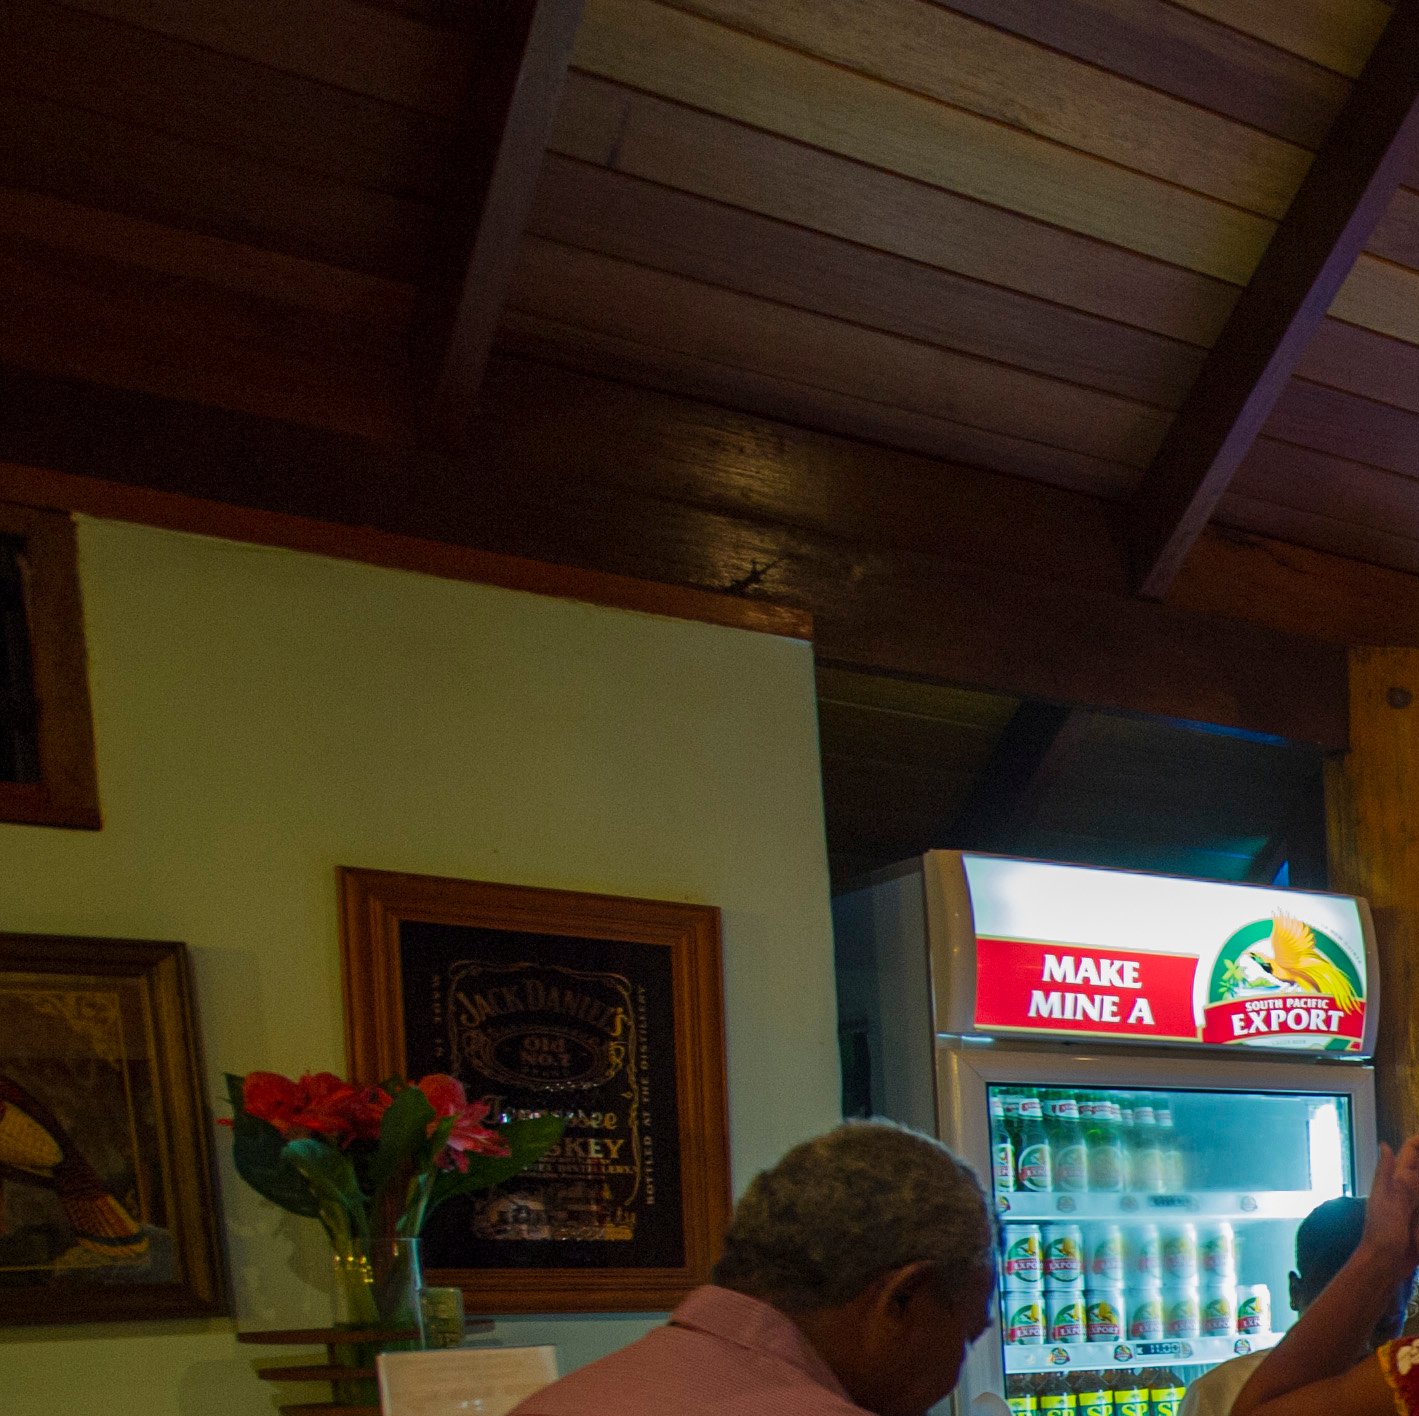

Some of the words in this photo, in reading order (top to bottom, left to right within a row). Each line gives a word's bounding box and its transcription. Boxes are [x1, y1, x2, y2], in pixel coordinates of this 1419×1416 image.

[1041, 954, 1142, 989] MAKE
[456, 985, 525, 1027] JACK
[1028, 990, 1118, 1023] MINE
[1127, 999, 1154, 1025] A
[1231, 1008, 1344, 1036] EXPORT
[1245, 998, 1283, 1011] SOUTH
[1286, 998, 1330, 1009] PACIFIC
[637, 985, 650, 1070] DISTILLERY
[640, 1077, 651, 1103] THE
[642, 1111, 652, 1127] AT
[643, 1136, 655, 1205] BOTTLED
